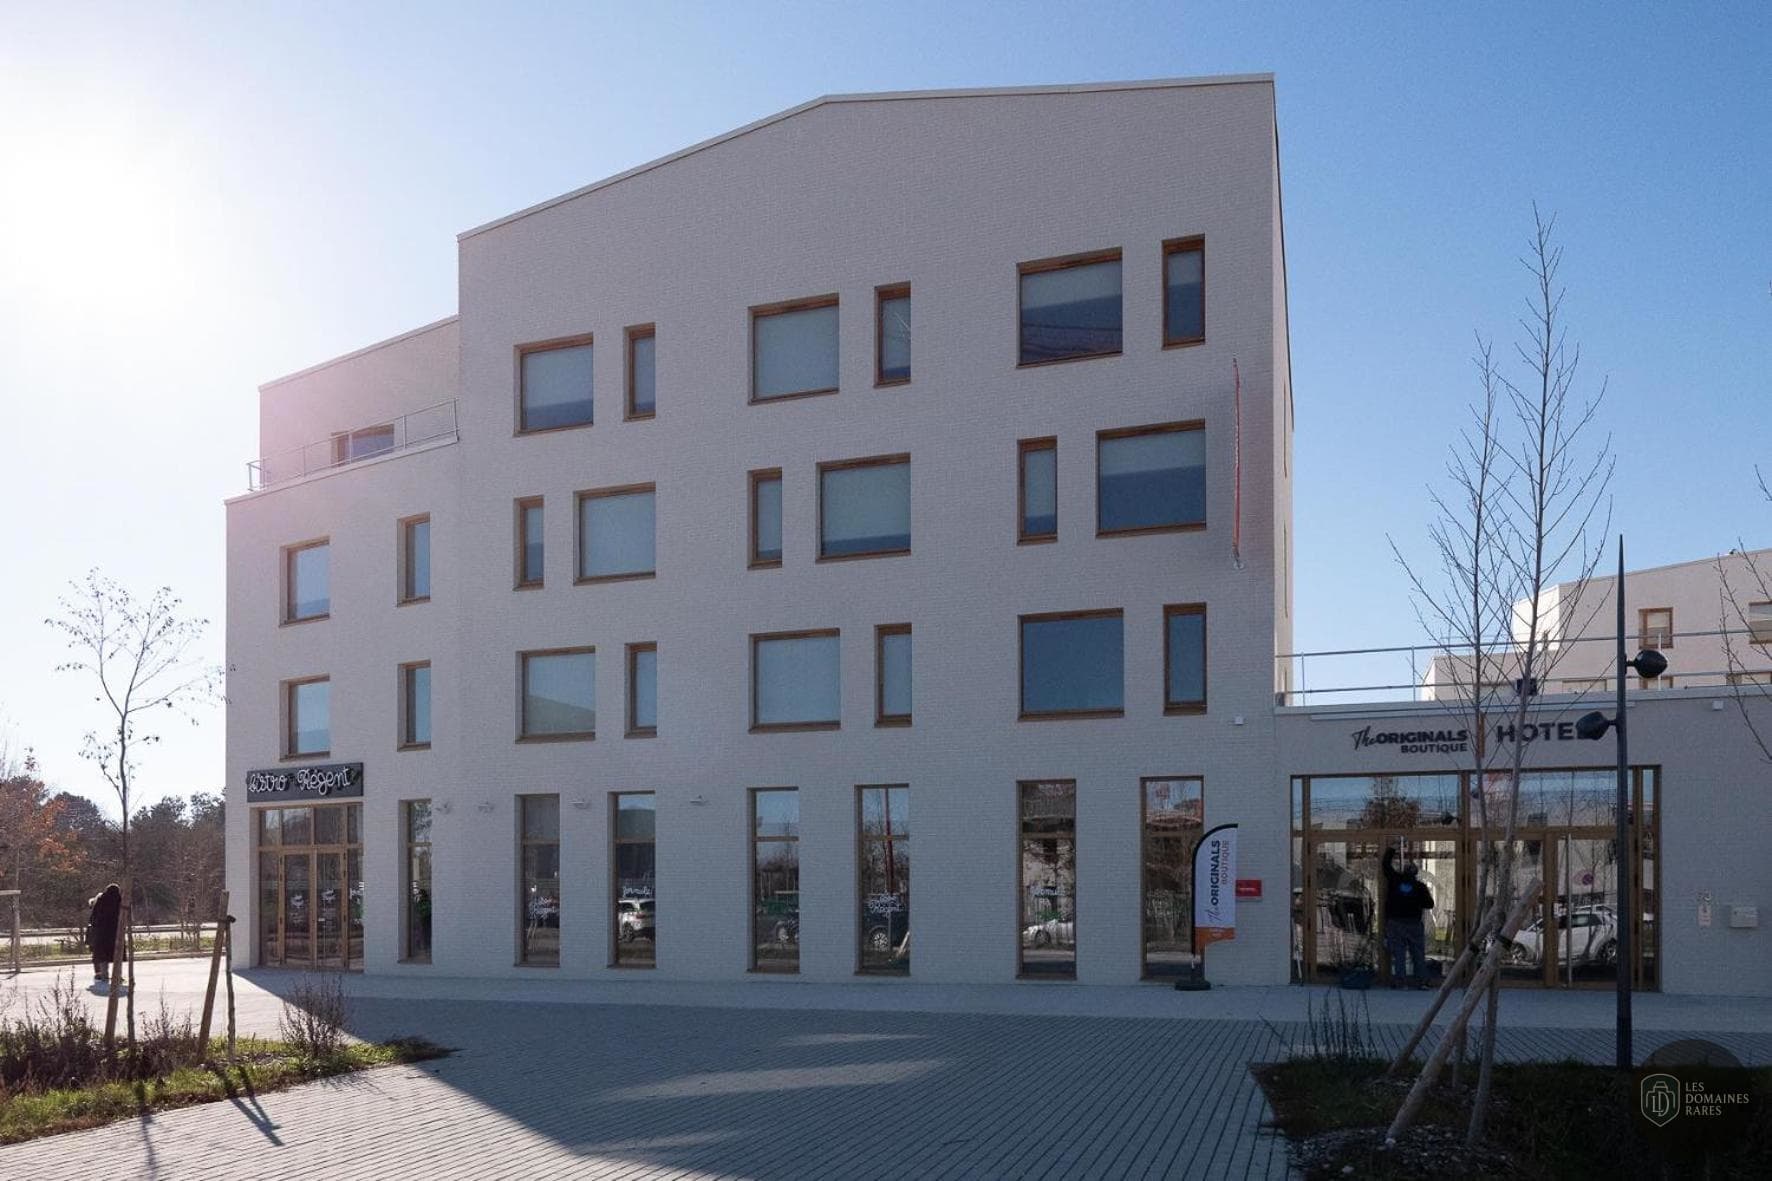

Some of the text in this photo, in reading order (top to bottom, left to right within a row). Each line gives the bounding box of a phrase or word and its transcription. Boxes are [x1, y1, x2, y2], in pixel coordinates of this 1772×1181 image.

[1376, 730, 1468, 744] ORIGINALS
[1401, 743, 1468, 754] BOUTIQUE
[1210, 840, 1220, 906] ORIGINALS
